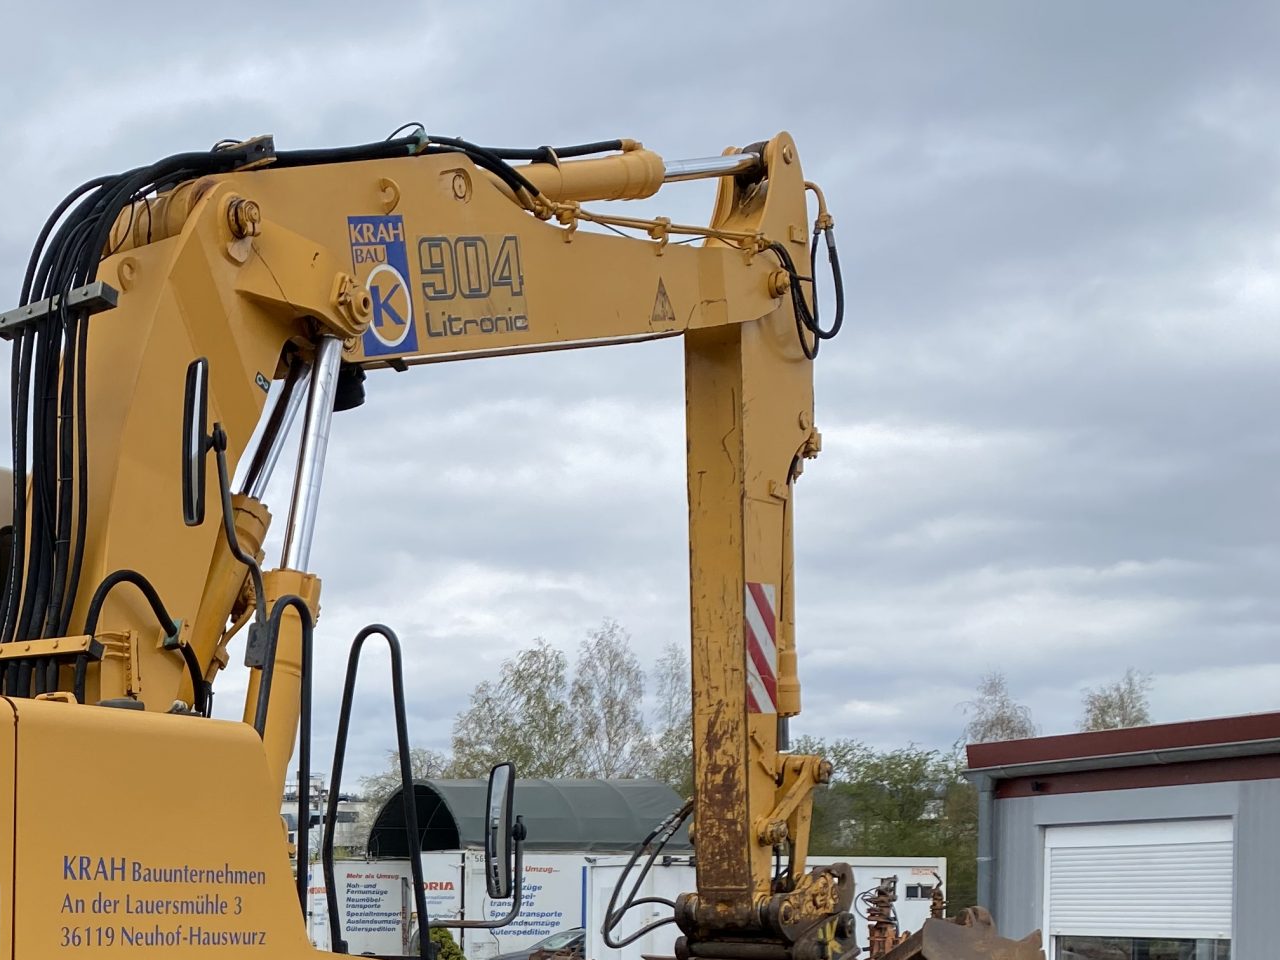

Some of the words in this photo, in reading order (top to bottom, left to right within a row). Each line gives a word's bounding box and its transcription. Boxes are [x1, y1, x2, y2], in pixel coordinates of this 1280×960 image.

[350, 222, 404, 244] KRAH
[355, 247, 386, 264] BAU
[418, 235, 524, 300] 904
[370, 283, 406, 328] K
[425, 307, 529, 337] Litronic
[63, 855, 126, 882] KRAH
[132, 861, 266, 885] Bauunternehmen
[61, 893, 85, 914] An
[92, 892, 120, 914] der
[126, 893, 228, 915] Lauersmühle
[234, 896, 242, 915] 3
[61, 926, 114, 947] 36119
[121, 925, 266, 947] Neuhof-Hauswurz
